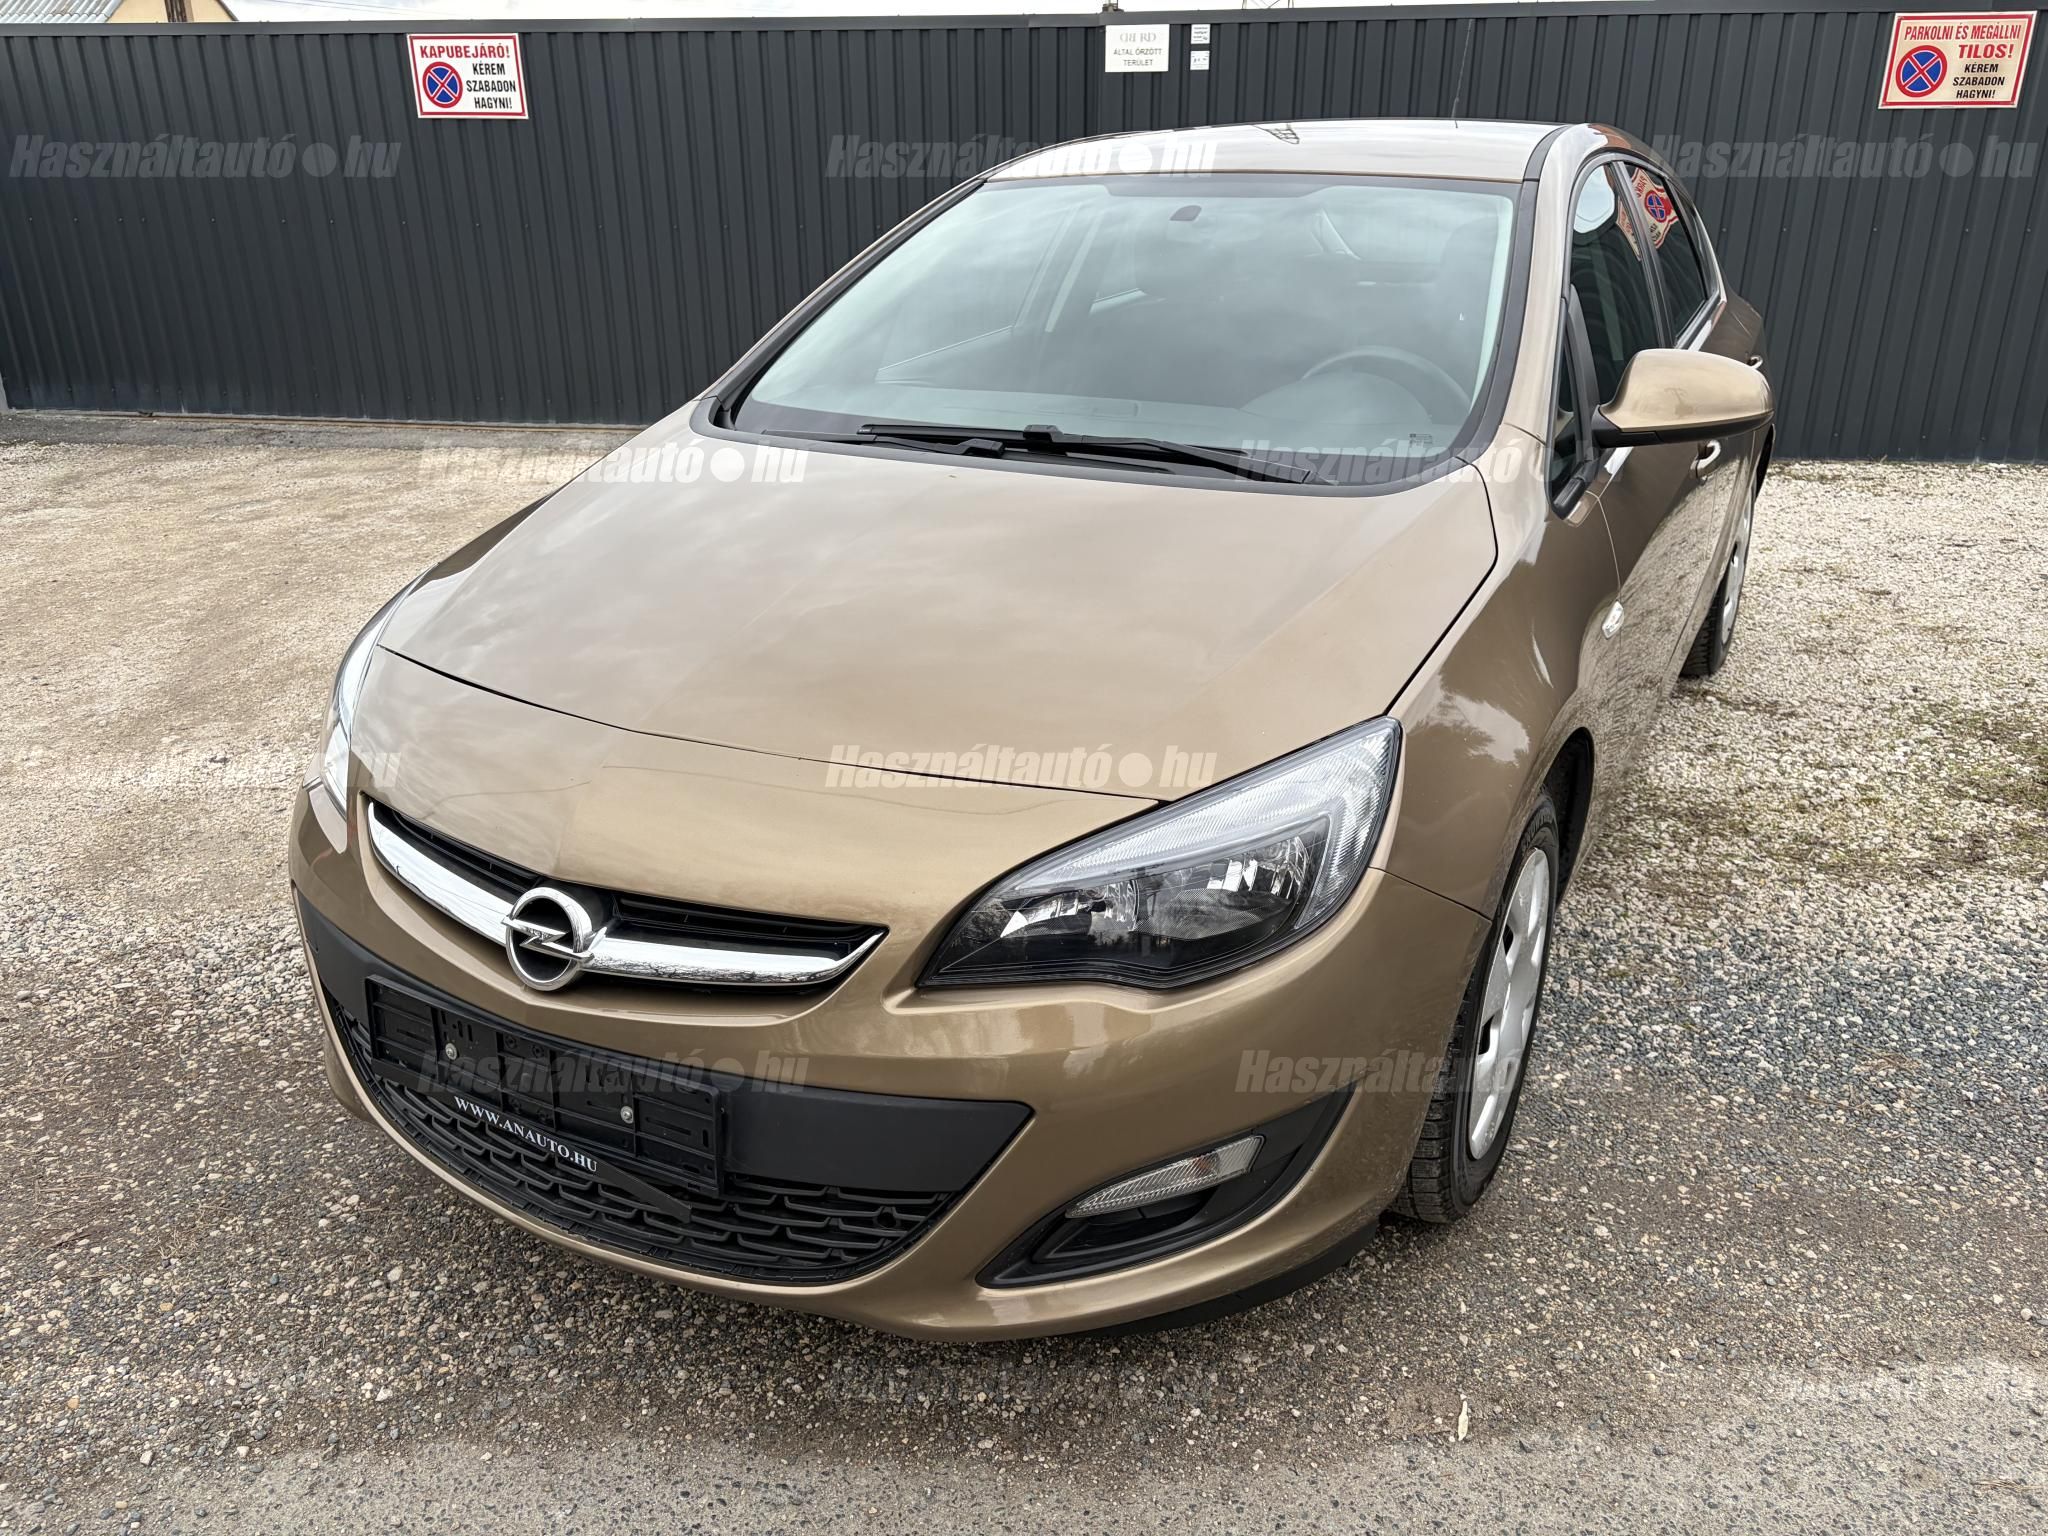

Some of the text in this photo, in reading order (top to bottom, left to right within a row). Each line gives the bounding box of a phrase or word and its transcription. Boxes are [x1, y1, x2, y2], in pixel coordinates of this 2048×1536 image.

[1904, 21, 2022, 41] PARKOLNI ÉS MEGÁLLNI
[420, 42, 510, 58] KAPUBEJÁRÓ!
[1958, 43, 2015, 59] TILOS!
[472, 60, 506, 76] KÉREM
[1964, 61, 1999, 74] KÉREM
[466, 79, 516, 93] SZABADON
[1952, 76, 2006, 87] SZABADON
[1956, 89, 1996, 100] HAGYNI!
[474, 96, 512, 110] HAGYNI!
[454, 1096, 597, 1172] WWW.ANAUTO.HU
